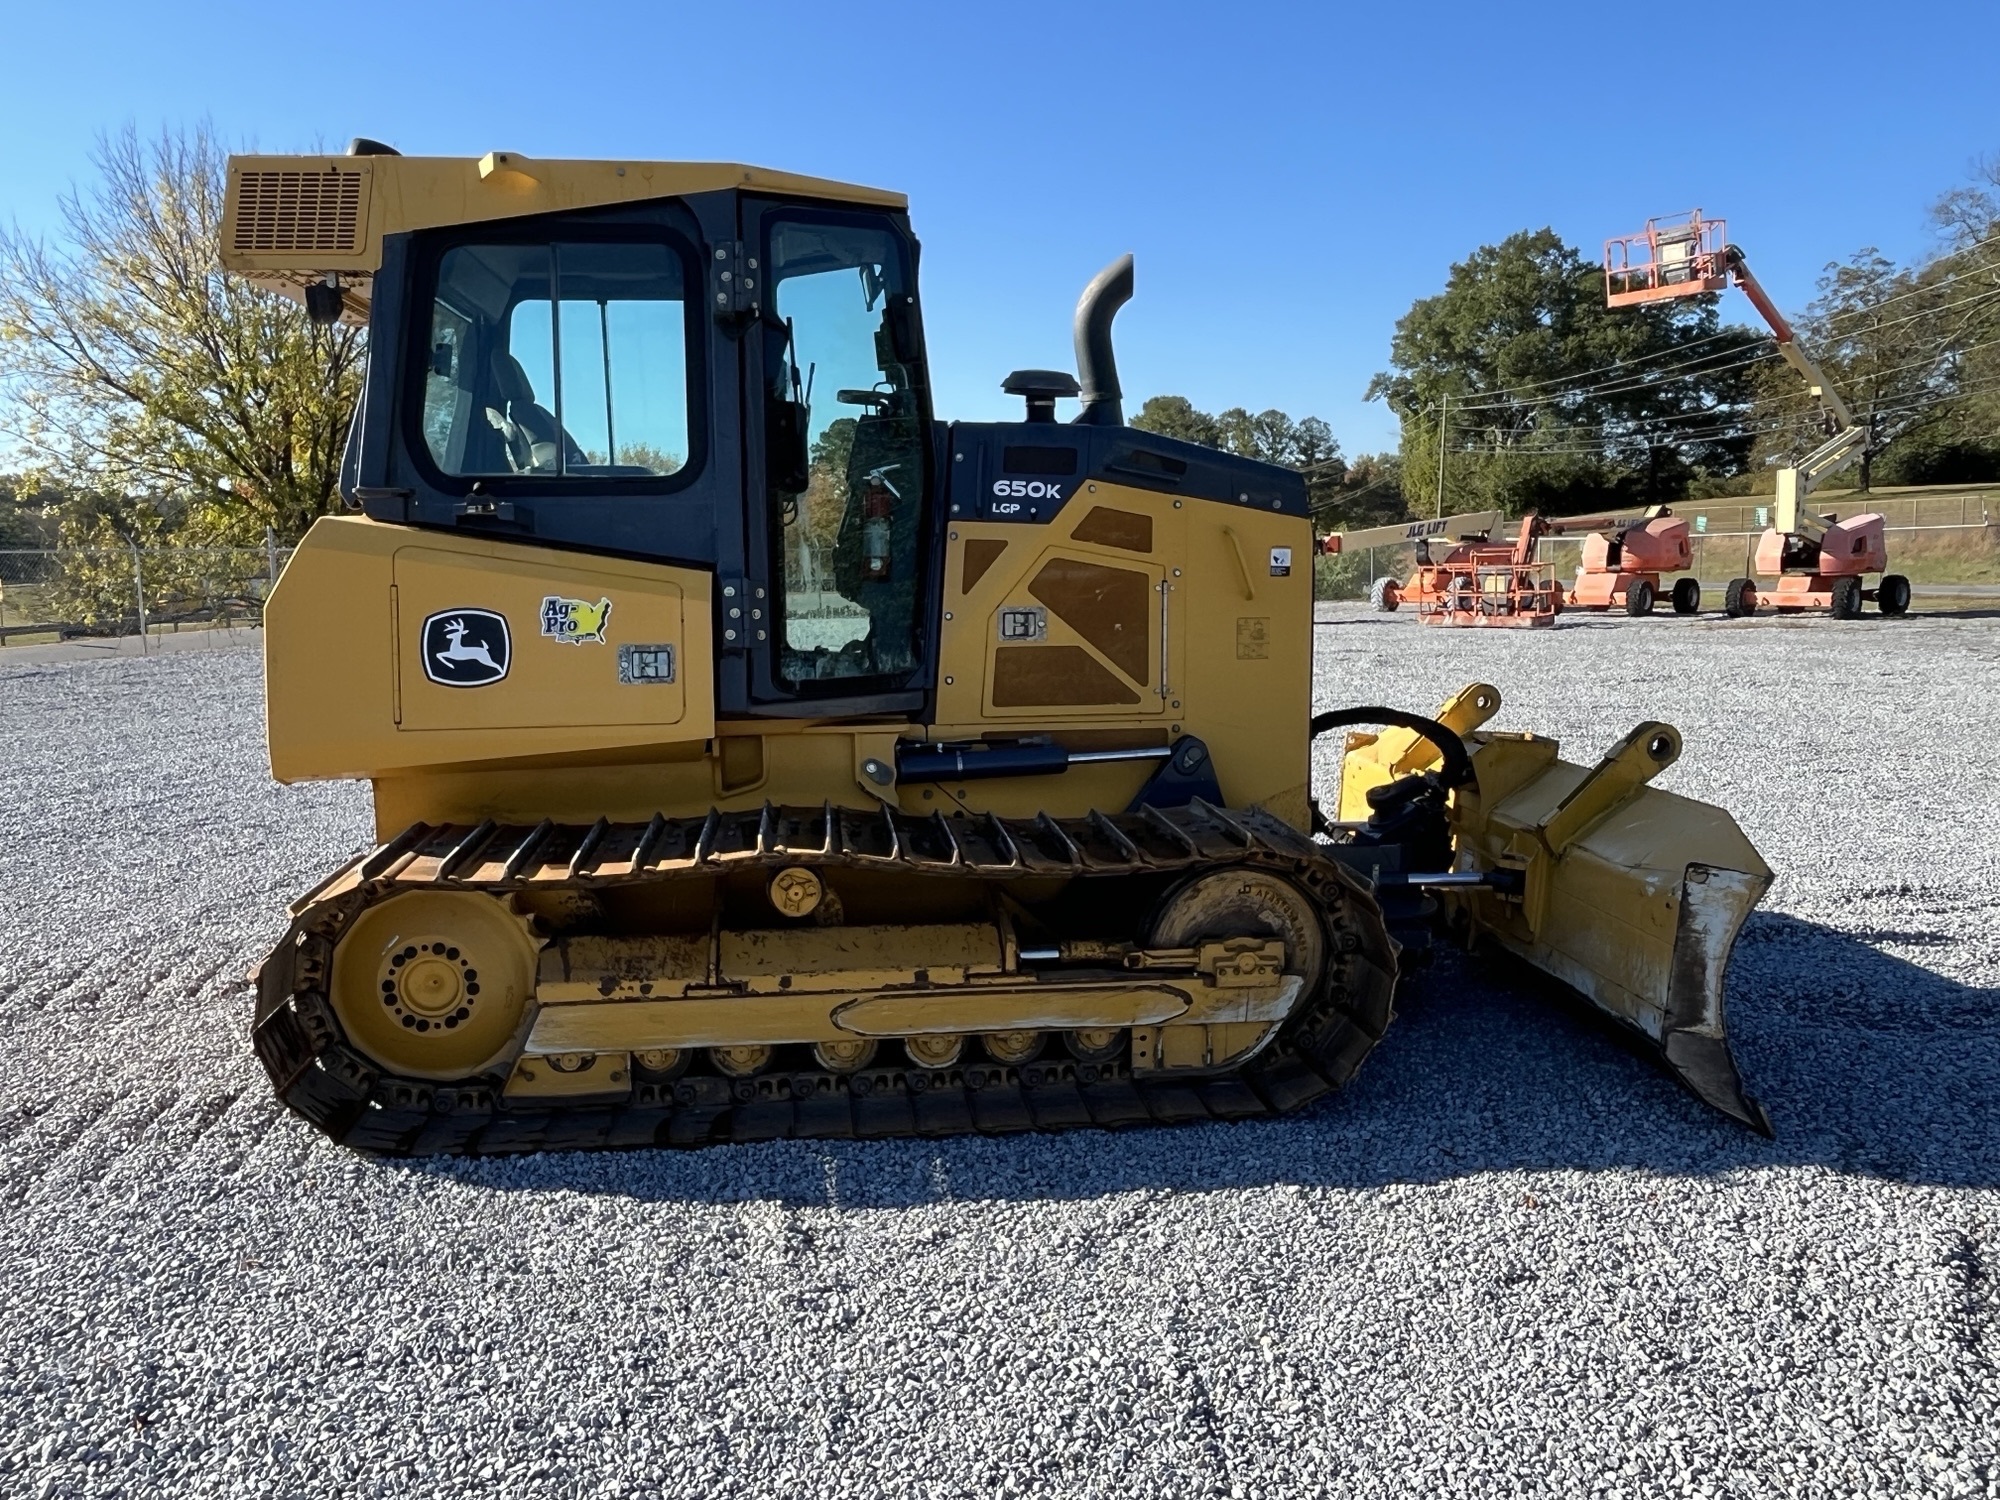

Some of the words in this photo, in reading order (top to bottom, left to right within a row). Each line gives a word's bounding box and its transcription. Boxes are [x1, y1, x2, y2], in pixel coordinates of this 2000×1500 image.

[993, 480, 1061, 499] 650K
[992, 502, 1020, 513] LGP
[1406, 524, 1425, 538] JLG
[1426, 520, 1448, 534] LIFT
[546, 617, 577, 632] Pro
